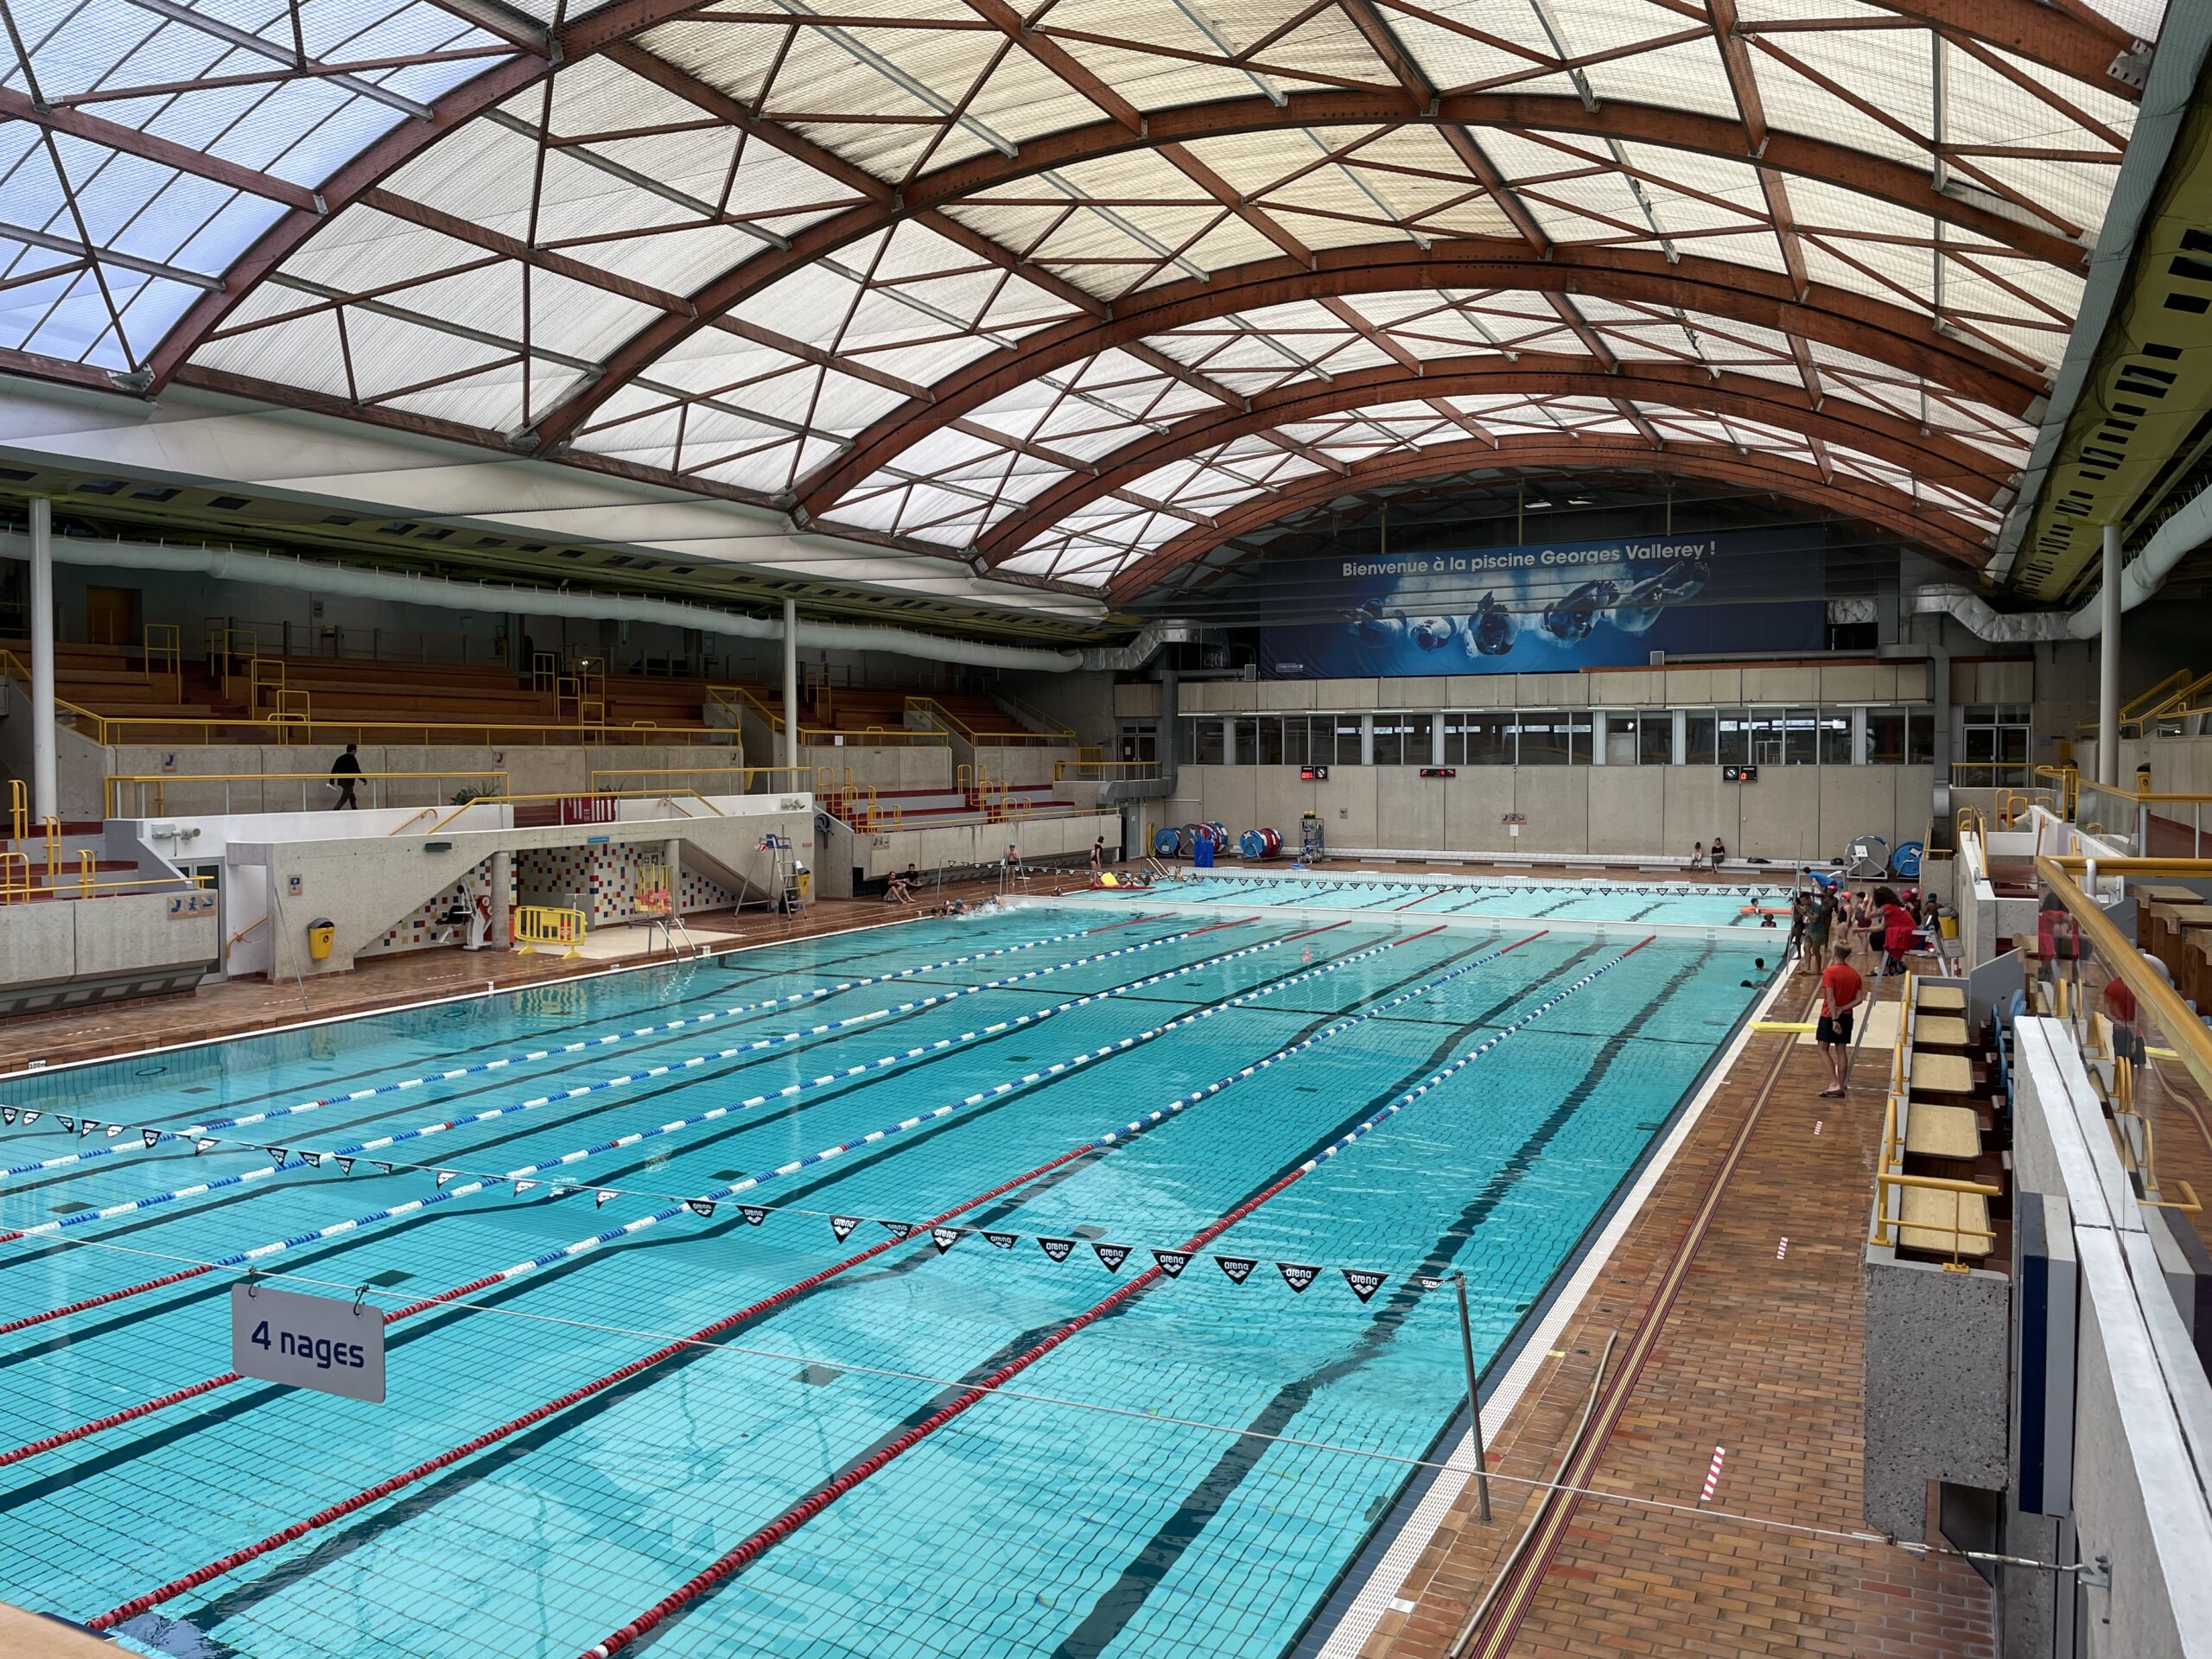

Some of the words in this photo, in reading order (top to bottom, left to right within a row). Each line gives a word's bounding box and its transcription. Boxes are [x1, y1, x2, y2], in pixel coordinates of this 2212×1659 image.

[1343, 562, 1428, 577] Bienvenue
[1433, 556, 1445, 571] à
[1450, 556, 1466, 570] la
[1471, 552, 1535, 572] piscine
[1541, 549, 1620, 567] Georges
[1625, 543, 1705, 560] Vallerey
[1710, 540, 1716, 556] !
[834, 1217, 855, 1228] arena
[934, 1229, 957, 1239] arena
[990, 1235, 1012, 1244] arena
[1046, 1243, 1069, 1251] arena
[1100, 1249, 1124, 1257] arena
[1160, 1254, 1185, 1264] arena
[1224, 1262, 1249, 1270] arena
[1286, 1268, 1312, 1279] arena
[1351, 1274, 1378, 1286] arena
[251, 1320, 271, 1351] 4
[281, 1332, 365, 1369] nages
